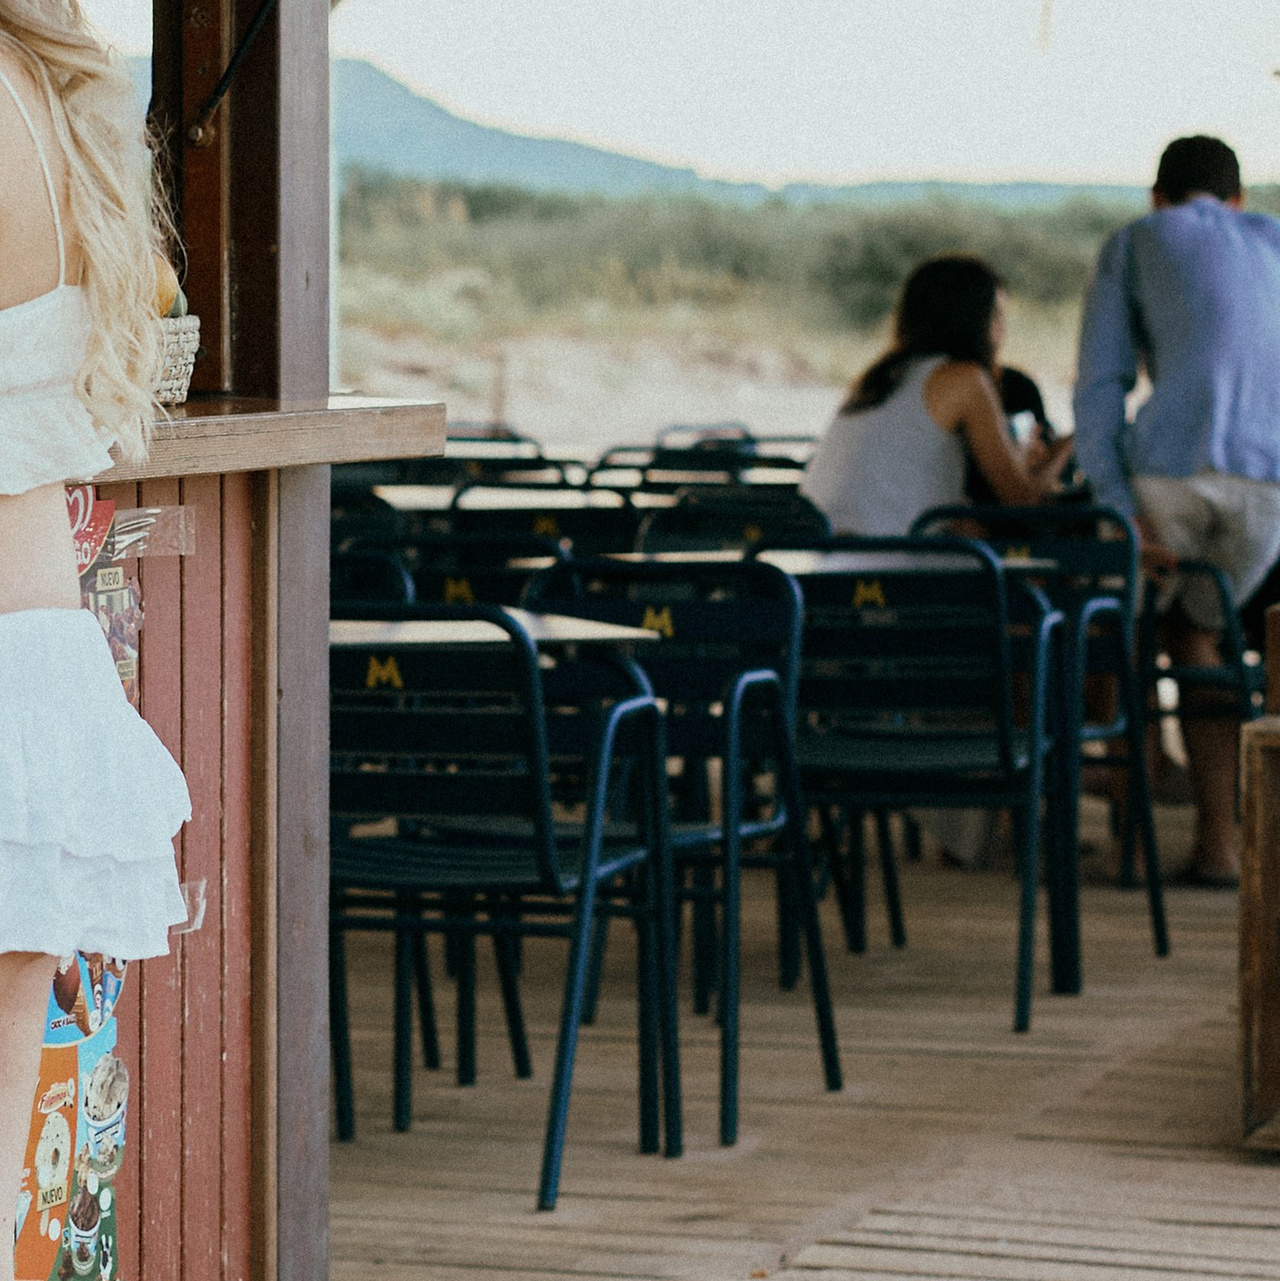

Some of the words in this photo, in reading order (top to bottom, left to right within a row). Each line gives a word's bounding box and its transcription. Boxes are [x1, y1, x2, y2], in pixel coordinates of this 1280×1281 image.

[100, 570, 120, 587] NUEVO
[365, 655, 404, 690] M
[41, 1186, 63, 1206] NUEVO
